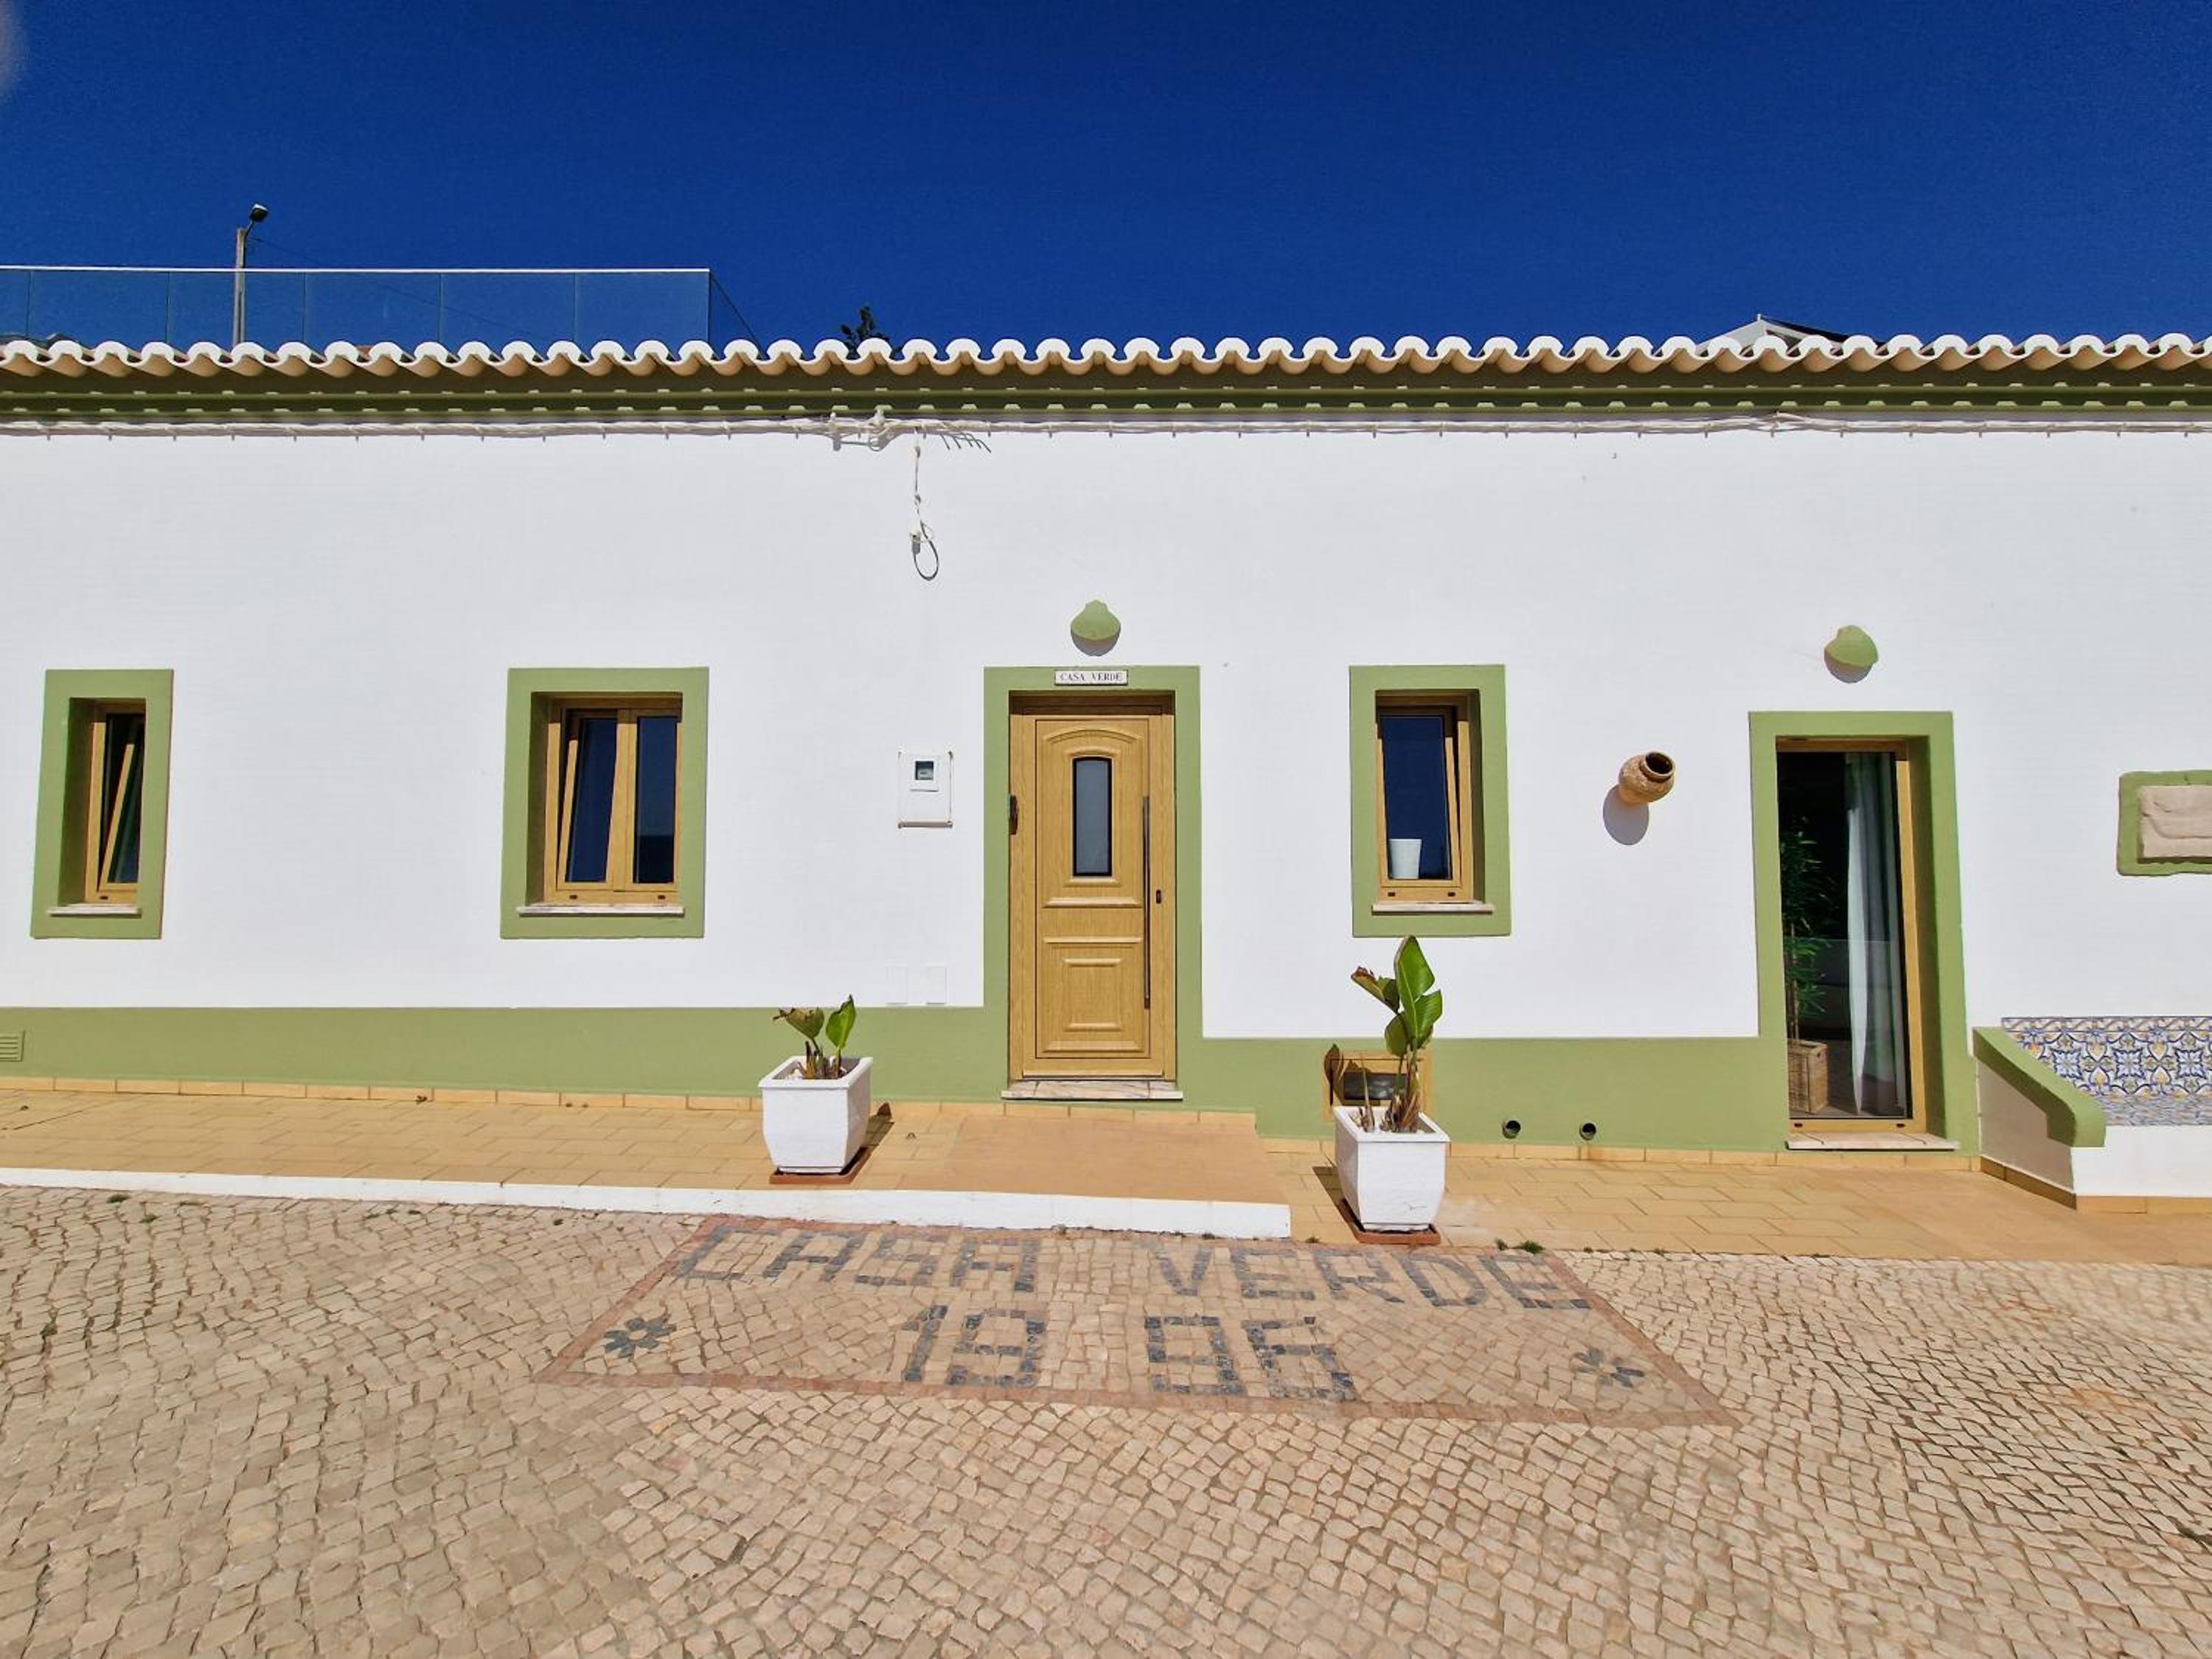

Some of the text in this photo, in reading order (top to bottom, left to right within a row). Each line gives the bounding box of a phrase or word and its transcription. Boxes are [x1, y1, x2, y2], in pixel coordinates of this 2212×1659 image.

[1060, 672, 1121, 681] CASA VERDE
[675, 1226, 1590, 1309] CASA VERDE
[900, 1304, 1357, 1400] 19 96
